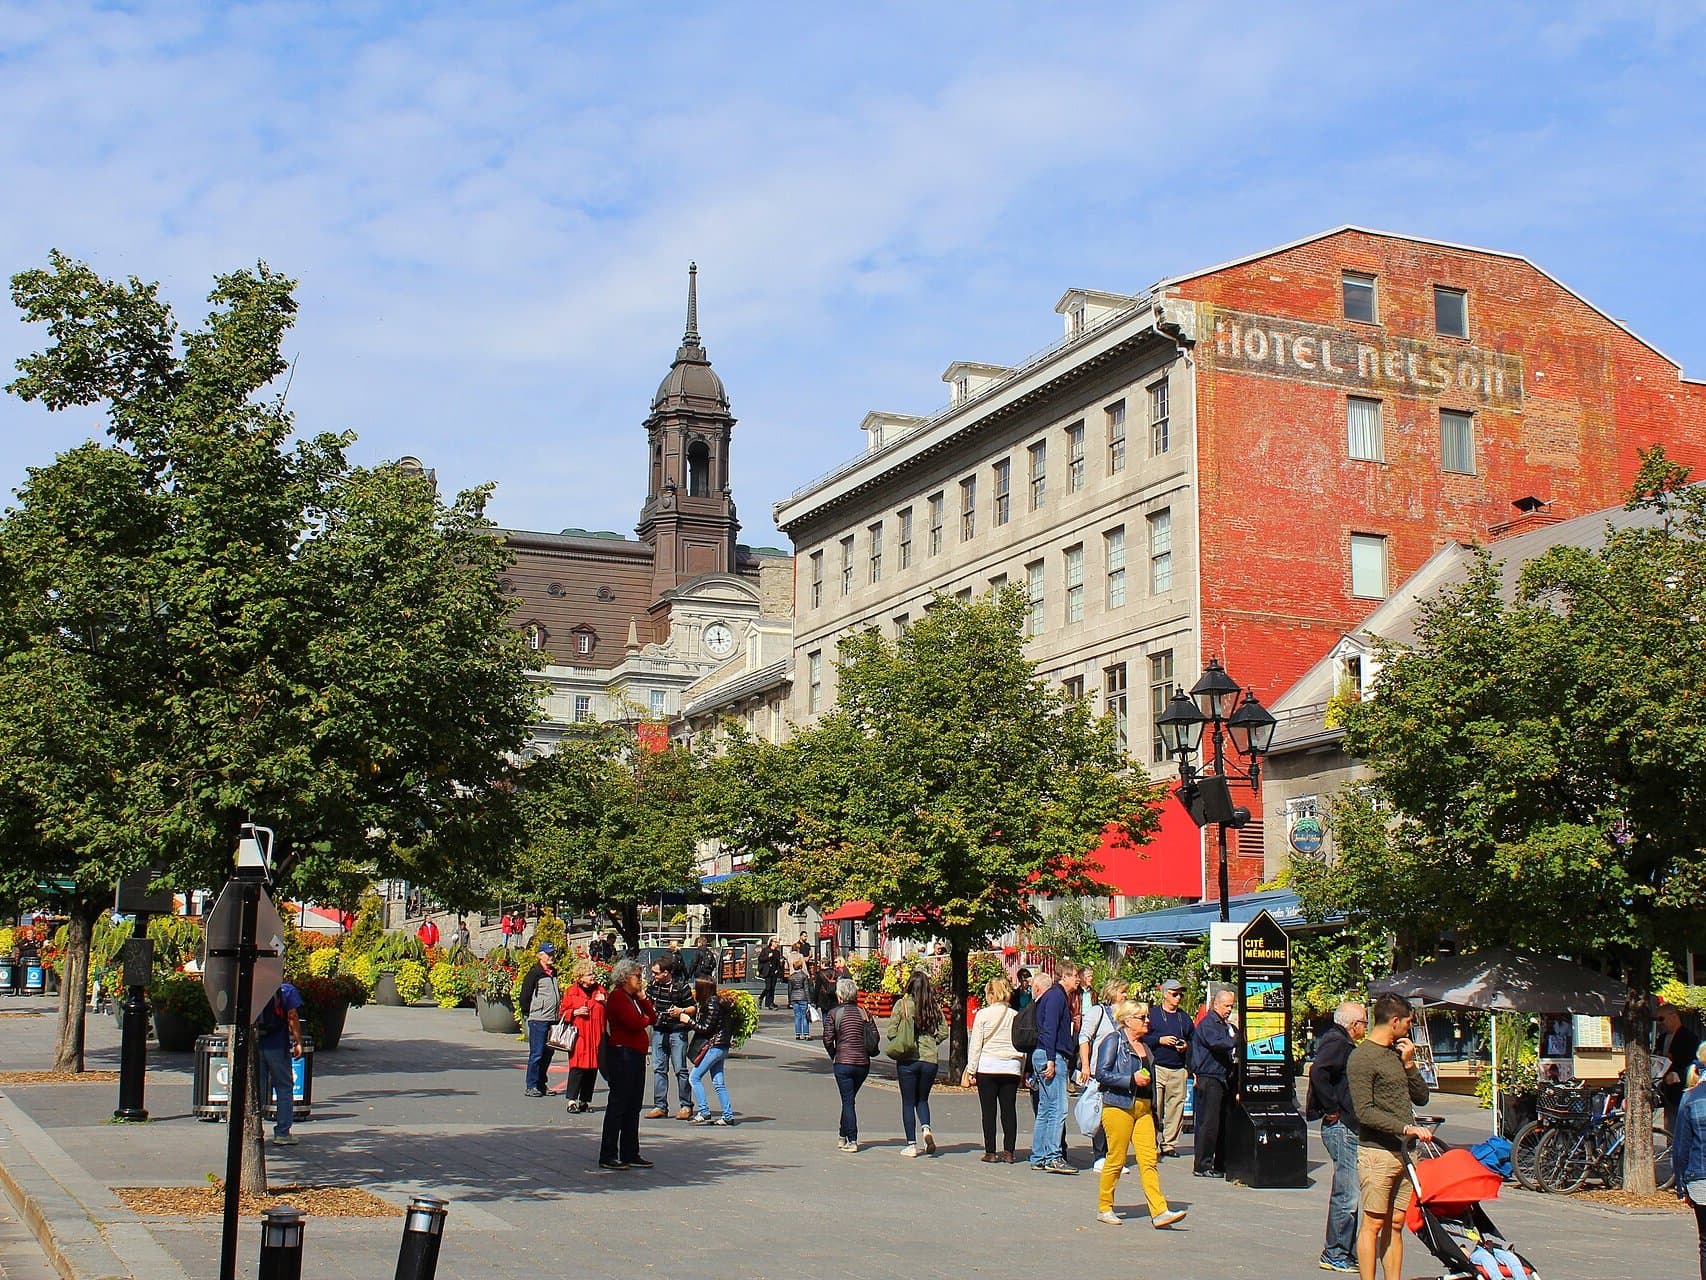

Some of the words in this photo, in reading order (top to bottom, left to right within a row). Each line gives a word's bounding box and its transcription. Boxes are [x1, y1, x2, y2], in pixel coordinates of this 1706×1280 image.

[1216, 320, 1343, 374] HOTEL
[1245, 937, 1265, 948] CITÉ
[1245, 948, 1286, 959] MÉMOIRE
